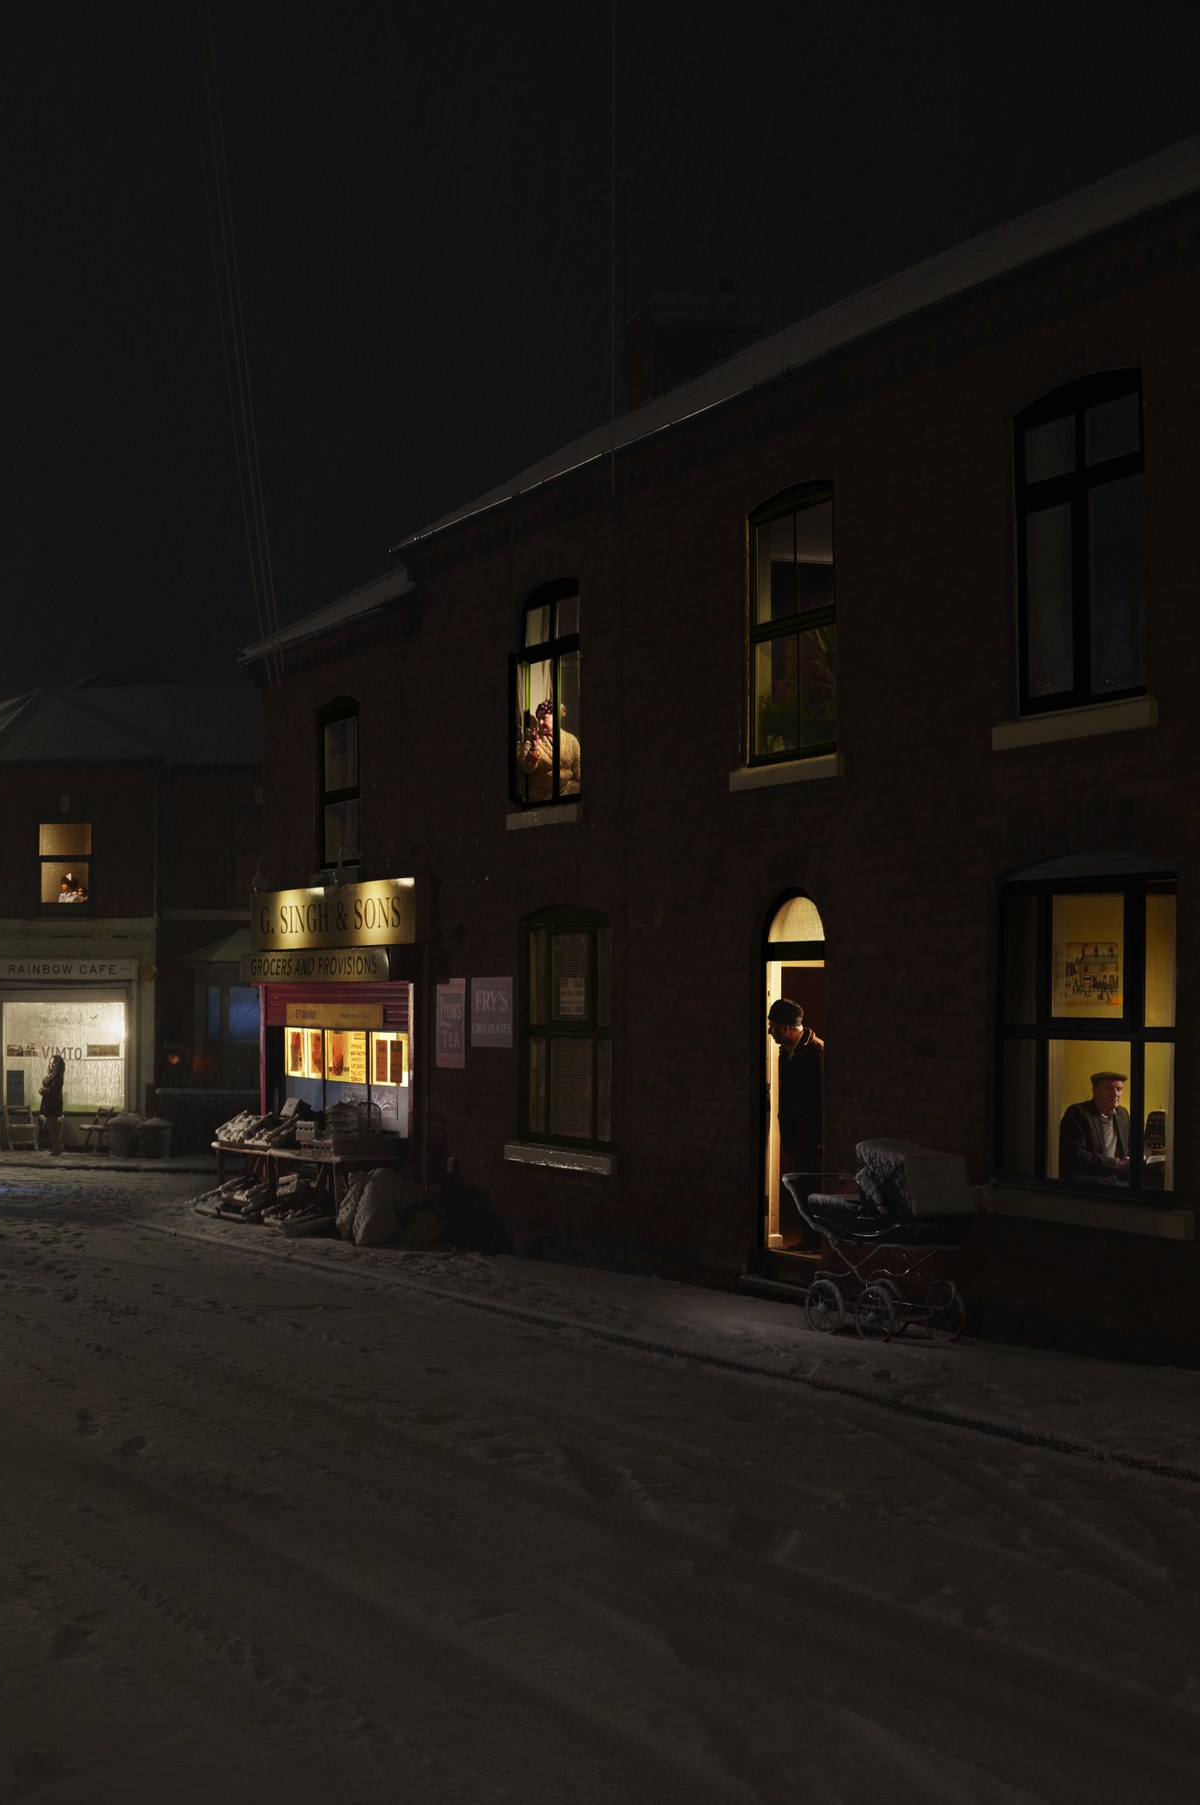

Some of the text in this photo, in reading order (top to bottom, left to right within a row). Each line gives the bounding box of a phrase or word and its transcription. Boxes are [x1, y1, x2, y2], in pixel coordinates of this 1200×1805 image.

[260, 896, 402, 936] G. SINGH & SONS
[8, 964, 117, 975] RAINBOW CAFE
[250, 955, 378, 977] GROCERS AND PROVISIONS
[475, 990, 509, 1012] FRY'S
[472, 1022, 513, 1034] CHOCOLATES
[441, 1029, 461, 1048] TEA
[41, 1046, 83, 1060] VIMTO
